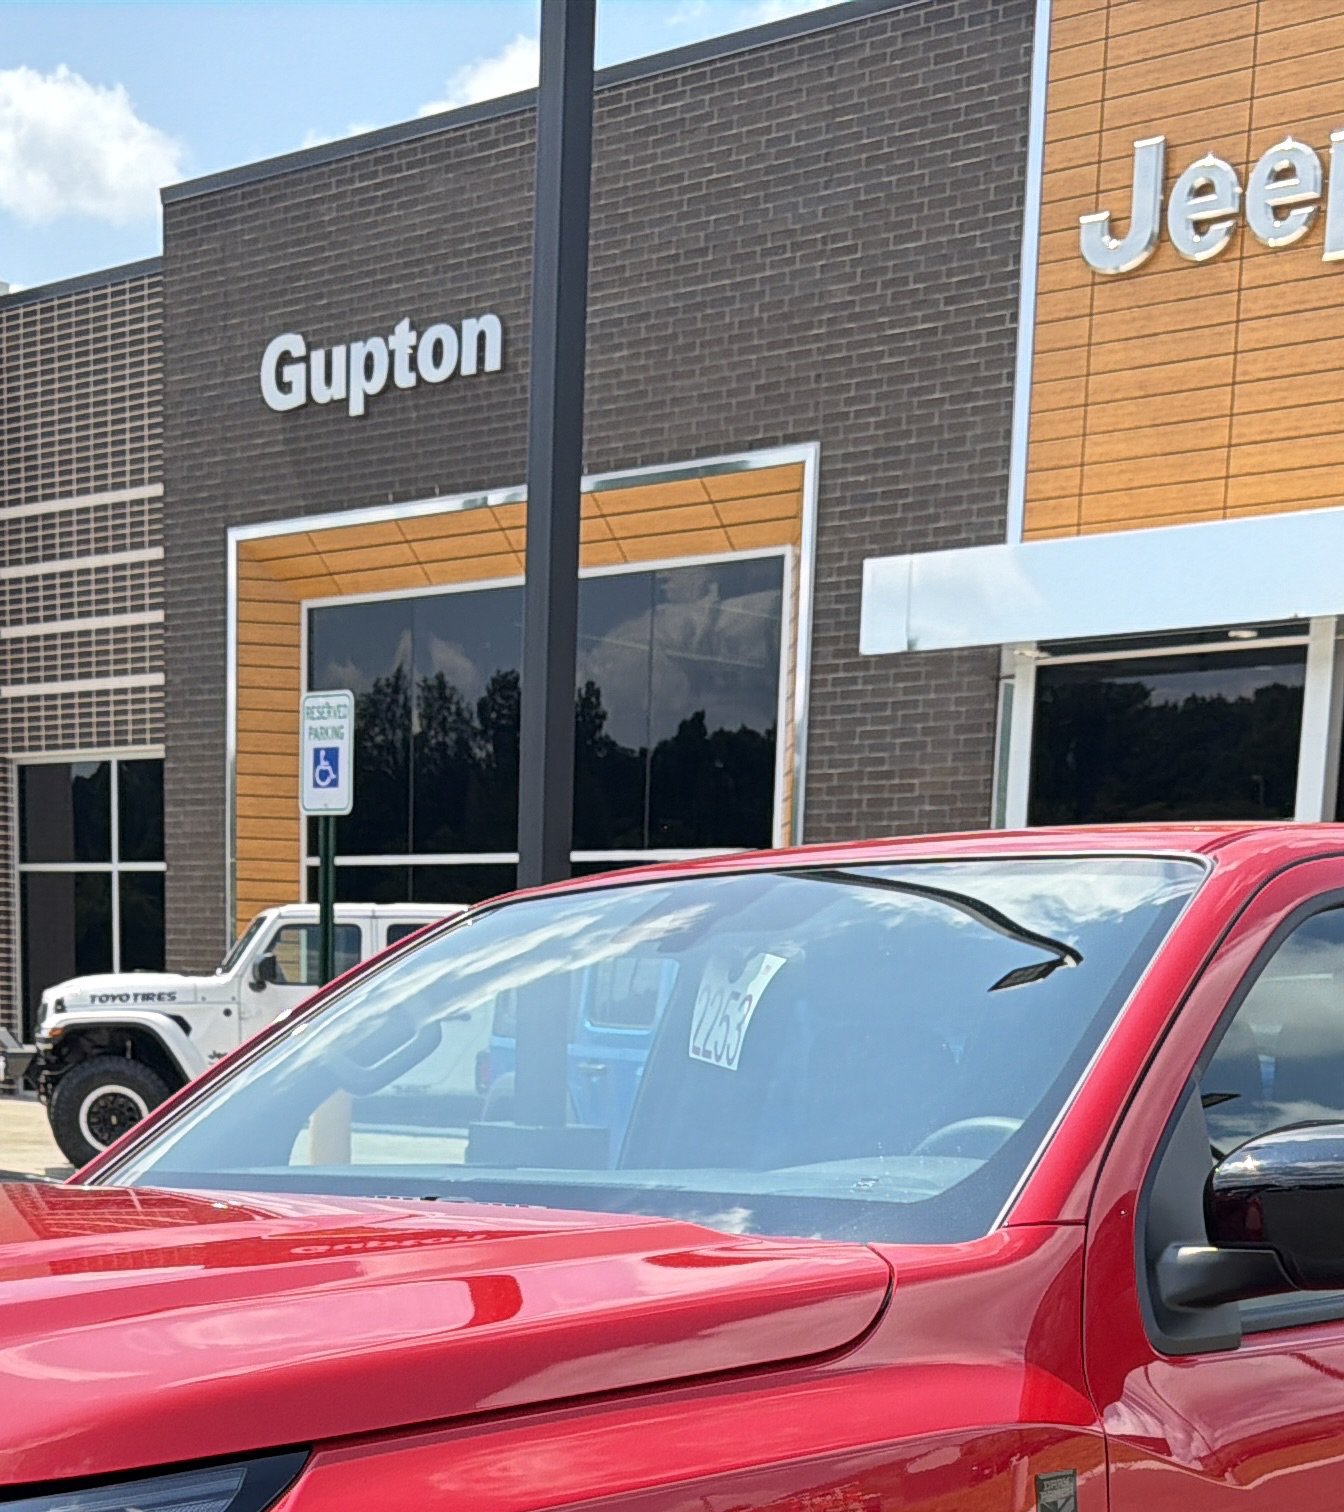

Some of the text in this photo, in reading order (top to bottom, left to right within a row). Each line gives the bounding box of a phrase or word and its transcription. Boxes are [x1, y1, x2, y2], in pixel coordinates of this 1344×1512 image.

[260, 312, 504, 416] Gupton
[89, 991, 177, 1004] TOYO TIRES
[692, 985, 753, 1066] 2253
